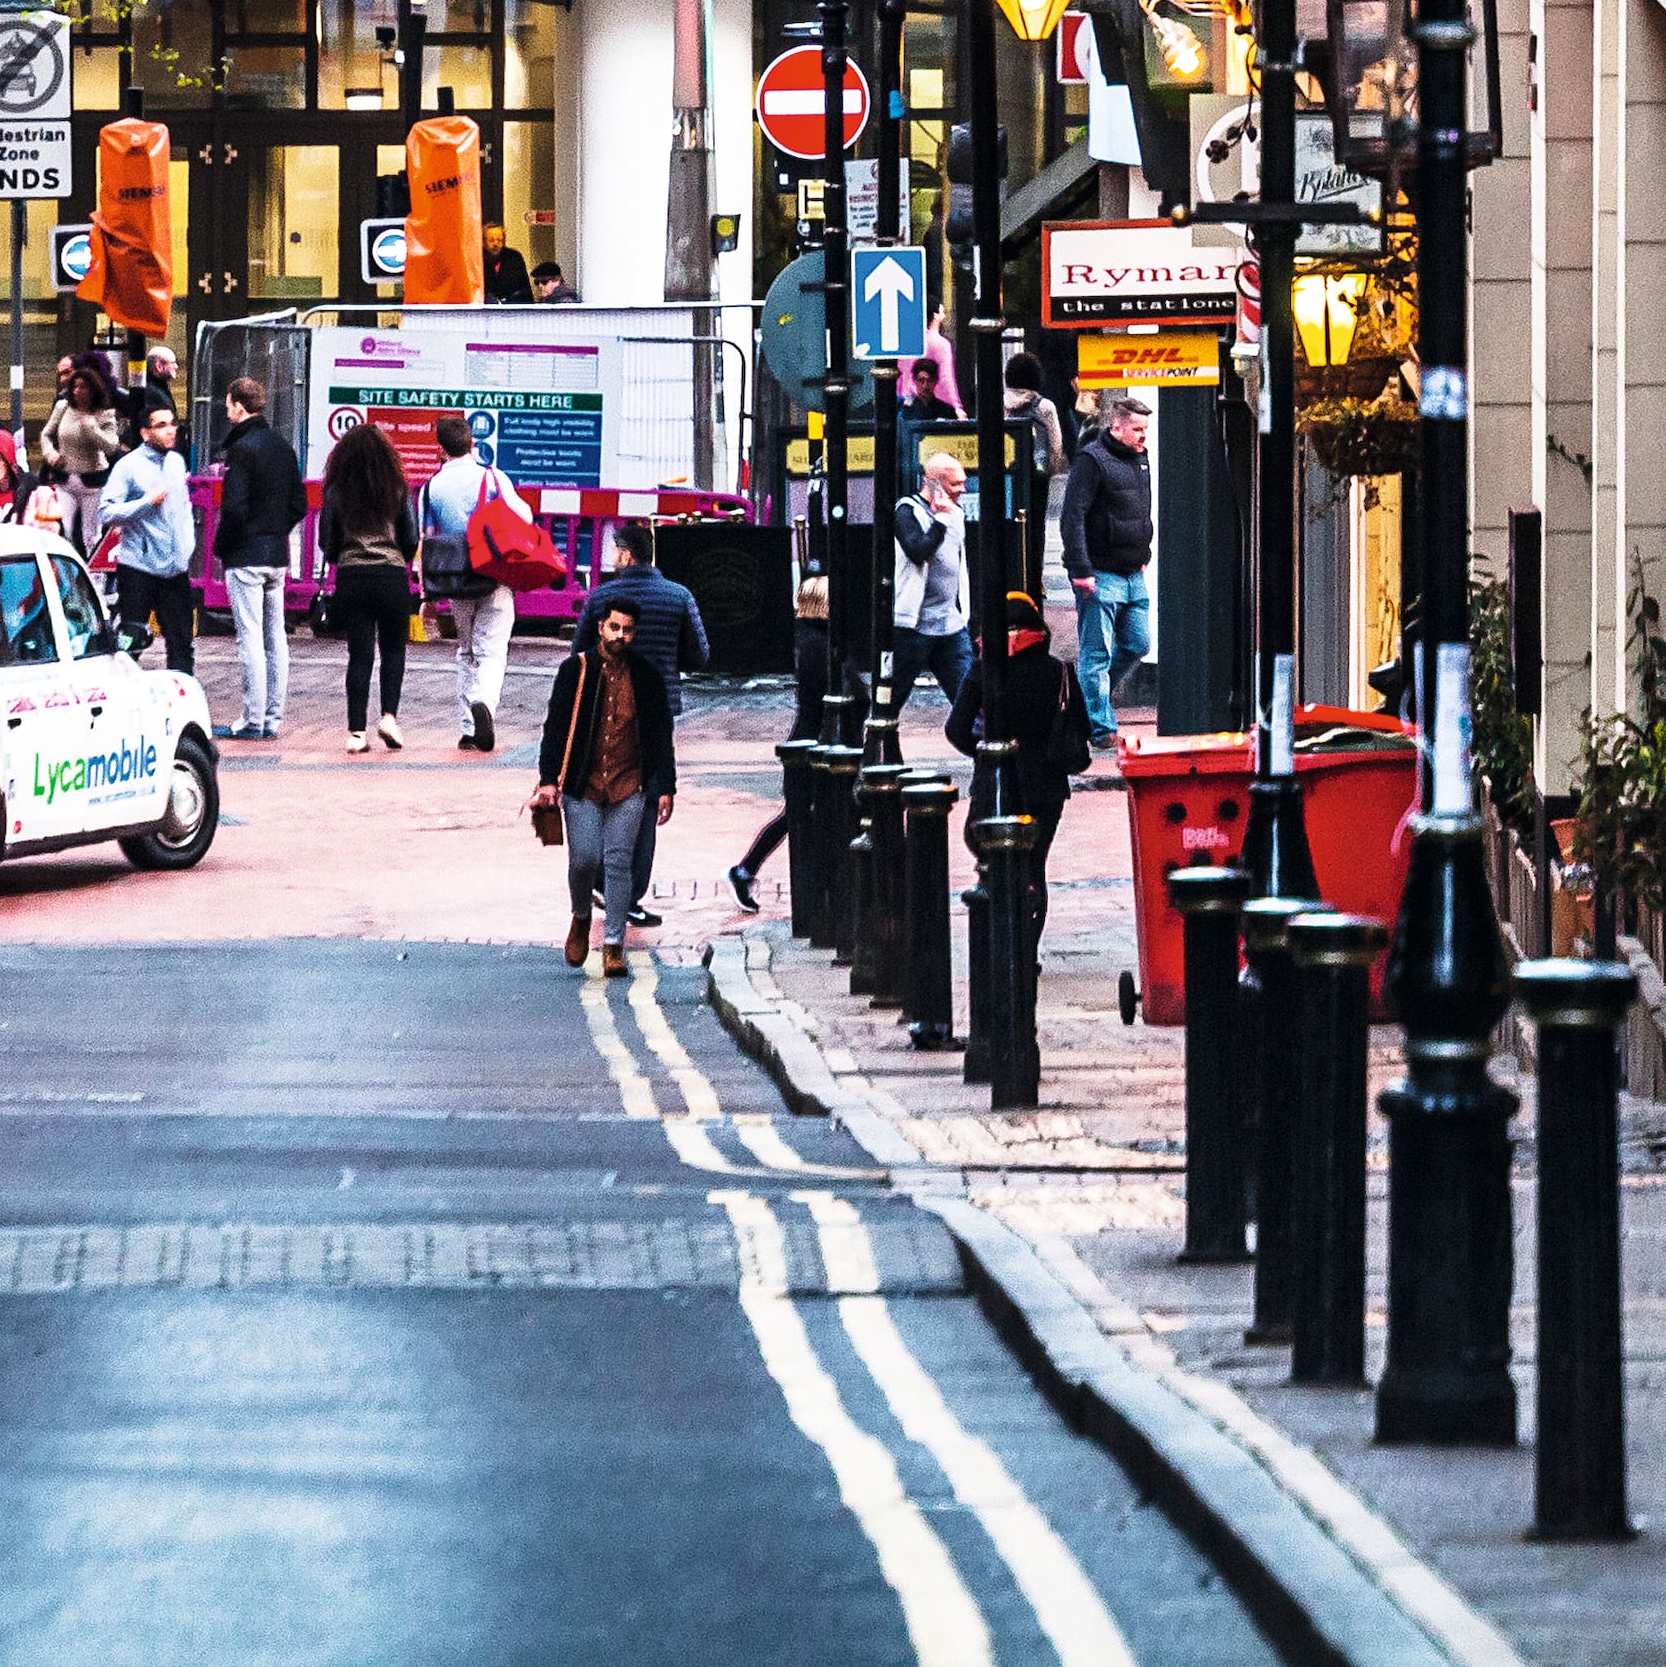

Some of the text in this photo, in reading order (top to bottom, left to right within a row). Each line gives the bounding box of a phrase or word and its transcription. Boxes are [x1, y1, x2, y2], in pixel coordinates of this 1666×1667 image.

[1062, 264, 1236, 288] Rymar
[1063, 297, 1234, 313] the statione
[1111, 347, 1184, 365] DHL
[358, 389, 573, 409] SITE SAFETY STARTS HERE
[33, 734, 157, 805] Lycamobile
